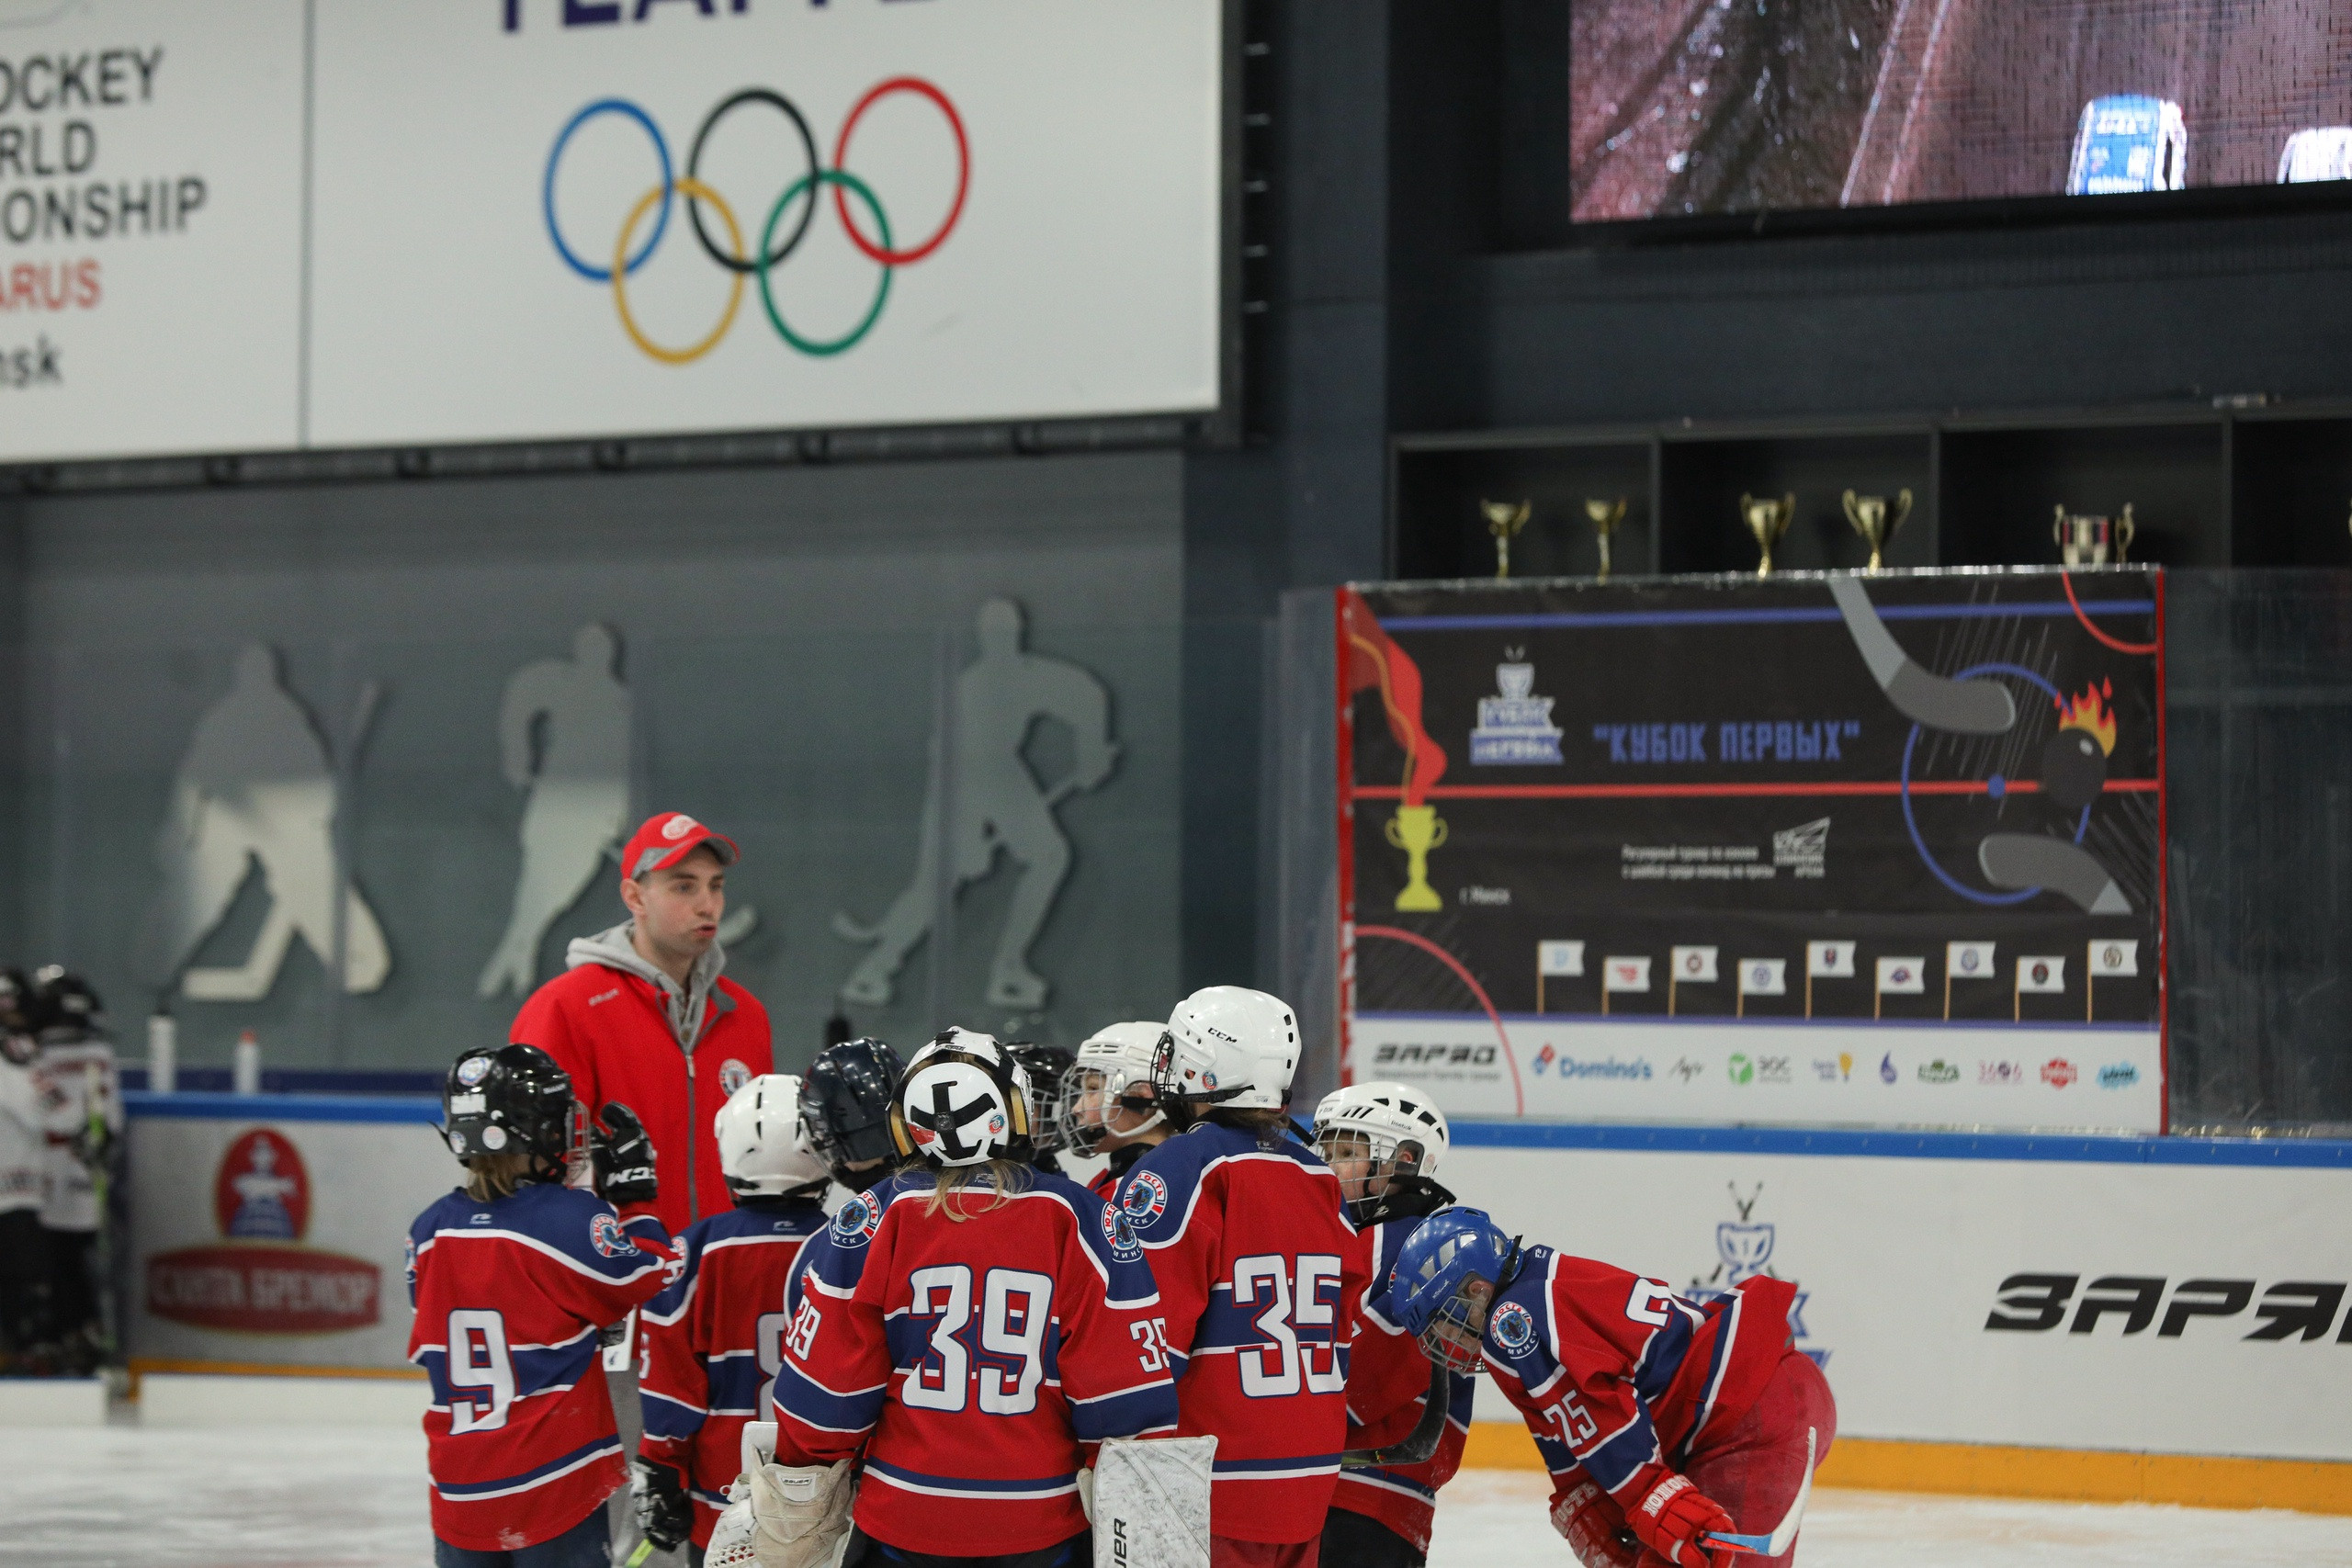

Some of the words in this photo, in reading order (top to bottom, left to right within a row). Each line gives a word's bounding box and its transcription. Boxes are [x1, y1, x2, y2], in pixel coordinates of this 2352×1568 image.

[2, 177, 208, 243] ONSHIP
[1208, 1027, 1238, 1043] CCM
[1560, 1055, 1652, 1081] Domino's
[785, 1294, 822, 1361] 39
[901, 1263, 1054, 1416] 39
[1233, 1252, 1347, 1398] 35
[447, 1310, 516, 1436] 9
[1544, 1389, 1600, 1450] 25
